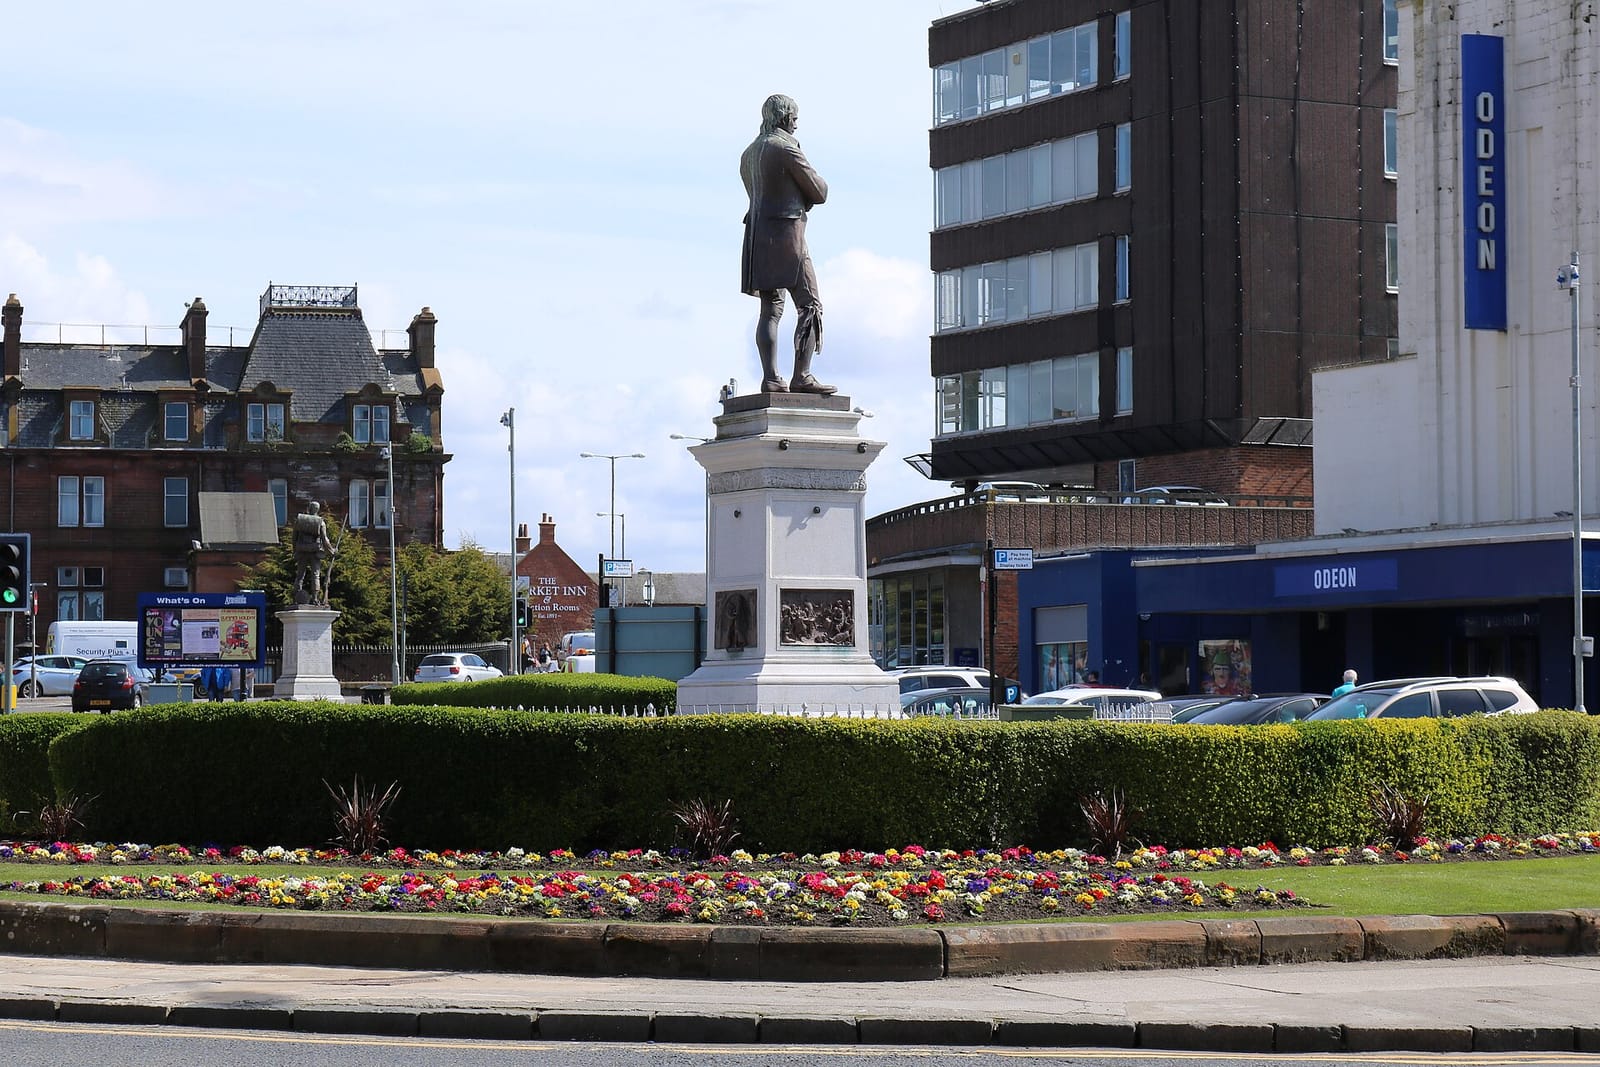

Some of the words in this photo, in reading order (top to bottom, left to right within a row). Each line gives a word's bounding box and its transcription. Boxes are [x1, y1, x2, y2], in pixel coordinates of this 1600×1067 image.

[1476, 92, 1495, 270] ODEON
[999, 552, 1006, 562] P
[538, 577, 556, 585] THE
[1314, 567, 1356, 589] ODEON
[529, 586, 560, 596] RKET
[563, 585, 588, 596] INN
[543, 596, 551, 604] &
[530, 603, 551, 611] ction
[552, 603, 580, 611] Rooms
[76, 648, 106, 656] Security
[1007, 687, 1015, 700] P
